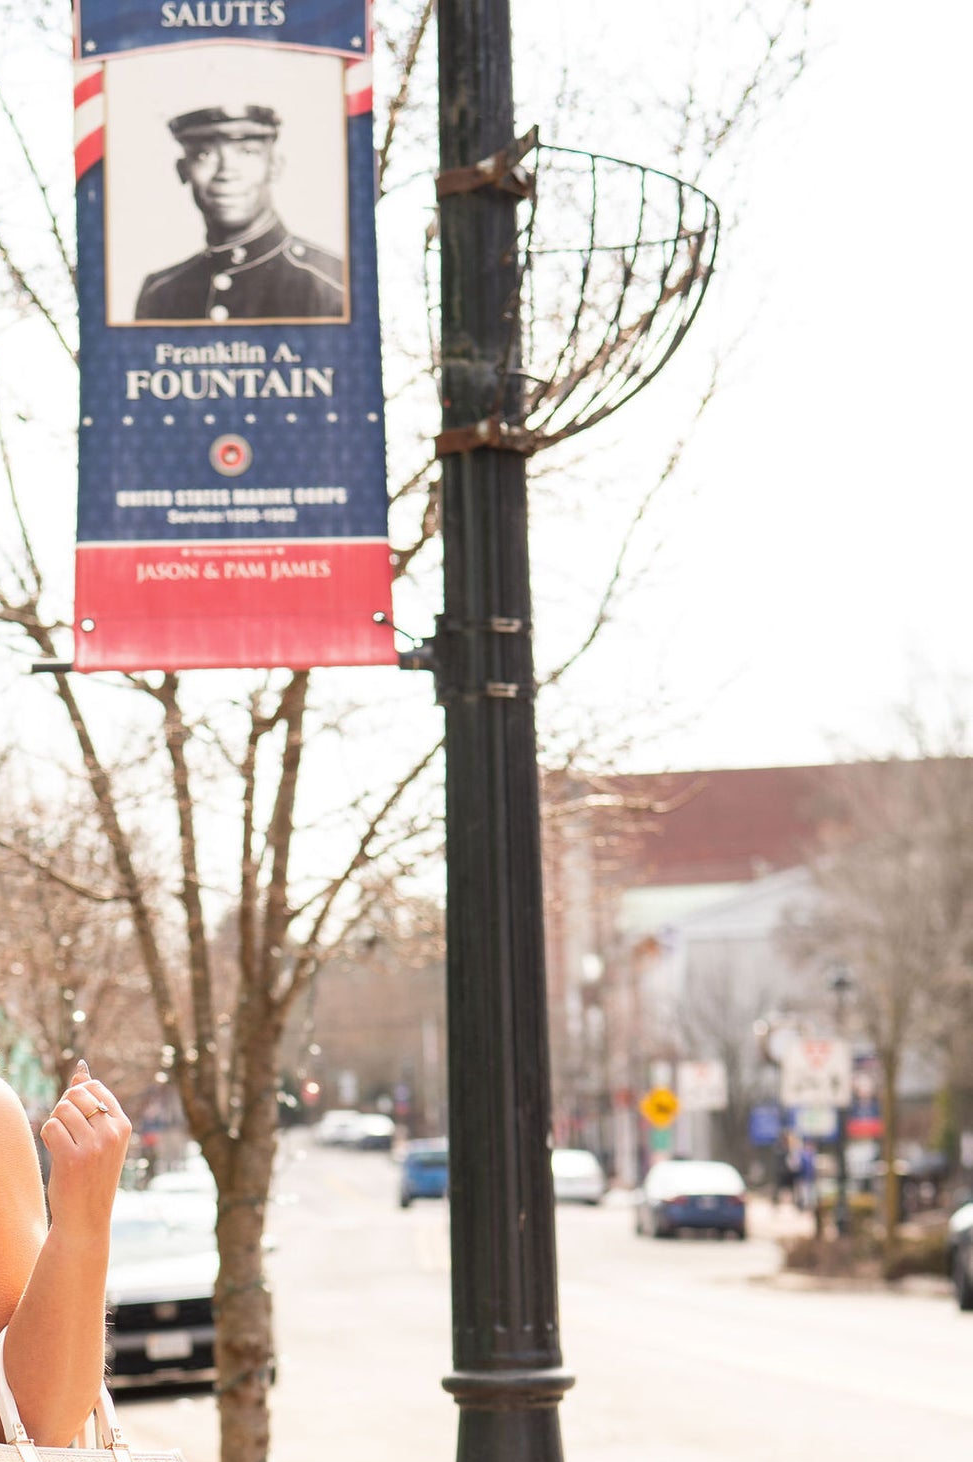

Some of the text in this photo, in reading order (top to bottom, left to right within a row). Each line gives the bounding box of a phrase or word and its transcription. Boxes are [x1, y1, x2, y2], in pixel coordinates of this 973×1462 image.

[161, 1, 286, 27] SALUTES
[156, 342, 301, 364] Franklin A.
[126, 368, 333, 400] FOUNTAIN
[116, 490, 173, 506] UNITED
[175, 489, 230, 505] STATES
[136, 559, 331, 582] JASON & PAM JAMES
